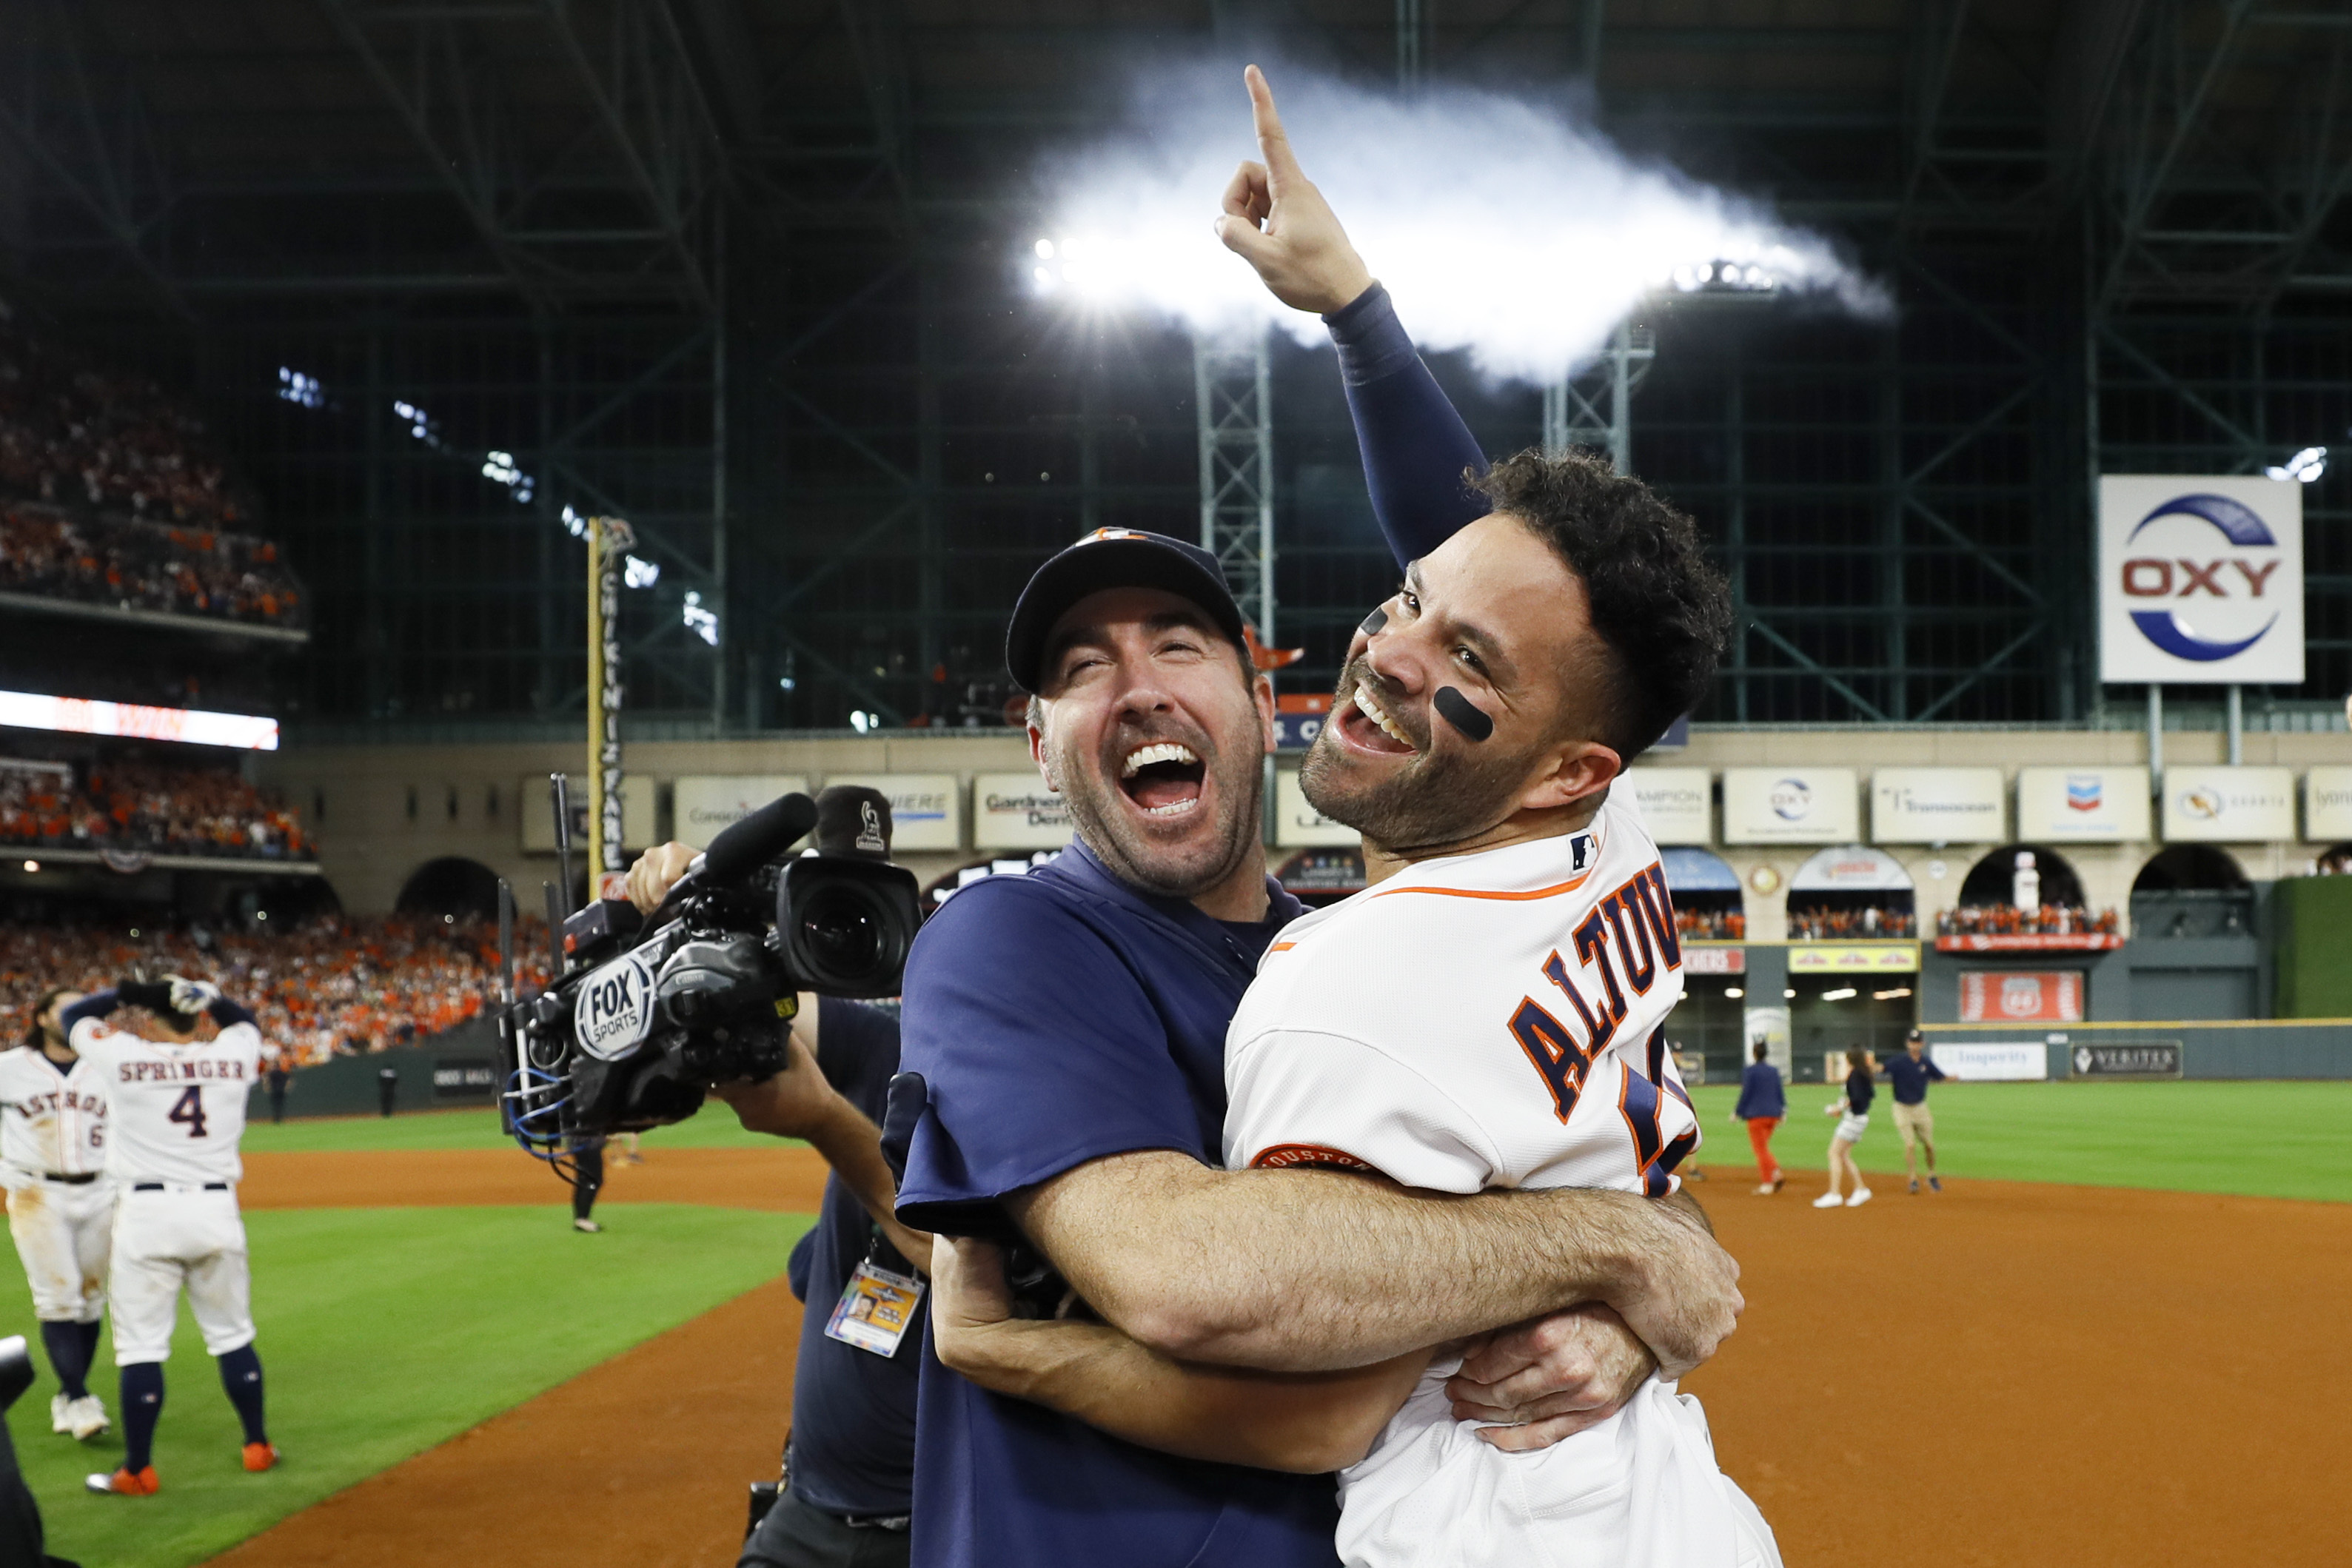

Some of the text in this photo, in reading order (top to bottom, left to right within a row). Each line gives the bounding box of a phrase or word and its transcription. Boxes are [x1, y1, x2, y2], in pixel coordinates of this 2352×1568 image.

[2123, 559, 2280, 597] OXY
[675, 974, 704, 985] Canon
[592, 968, 634, 1025] FOX
[594, 1010, 638, 1042] SPORTS
[118, 1061, 244, 1082] SPRINGER
[169, 1085, 208, 1138] 4
[90, 1124, 104, 1147] 6
[1262, 1150, 1370, 1171] OUSTON
